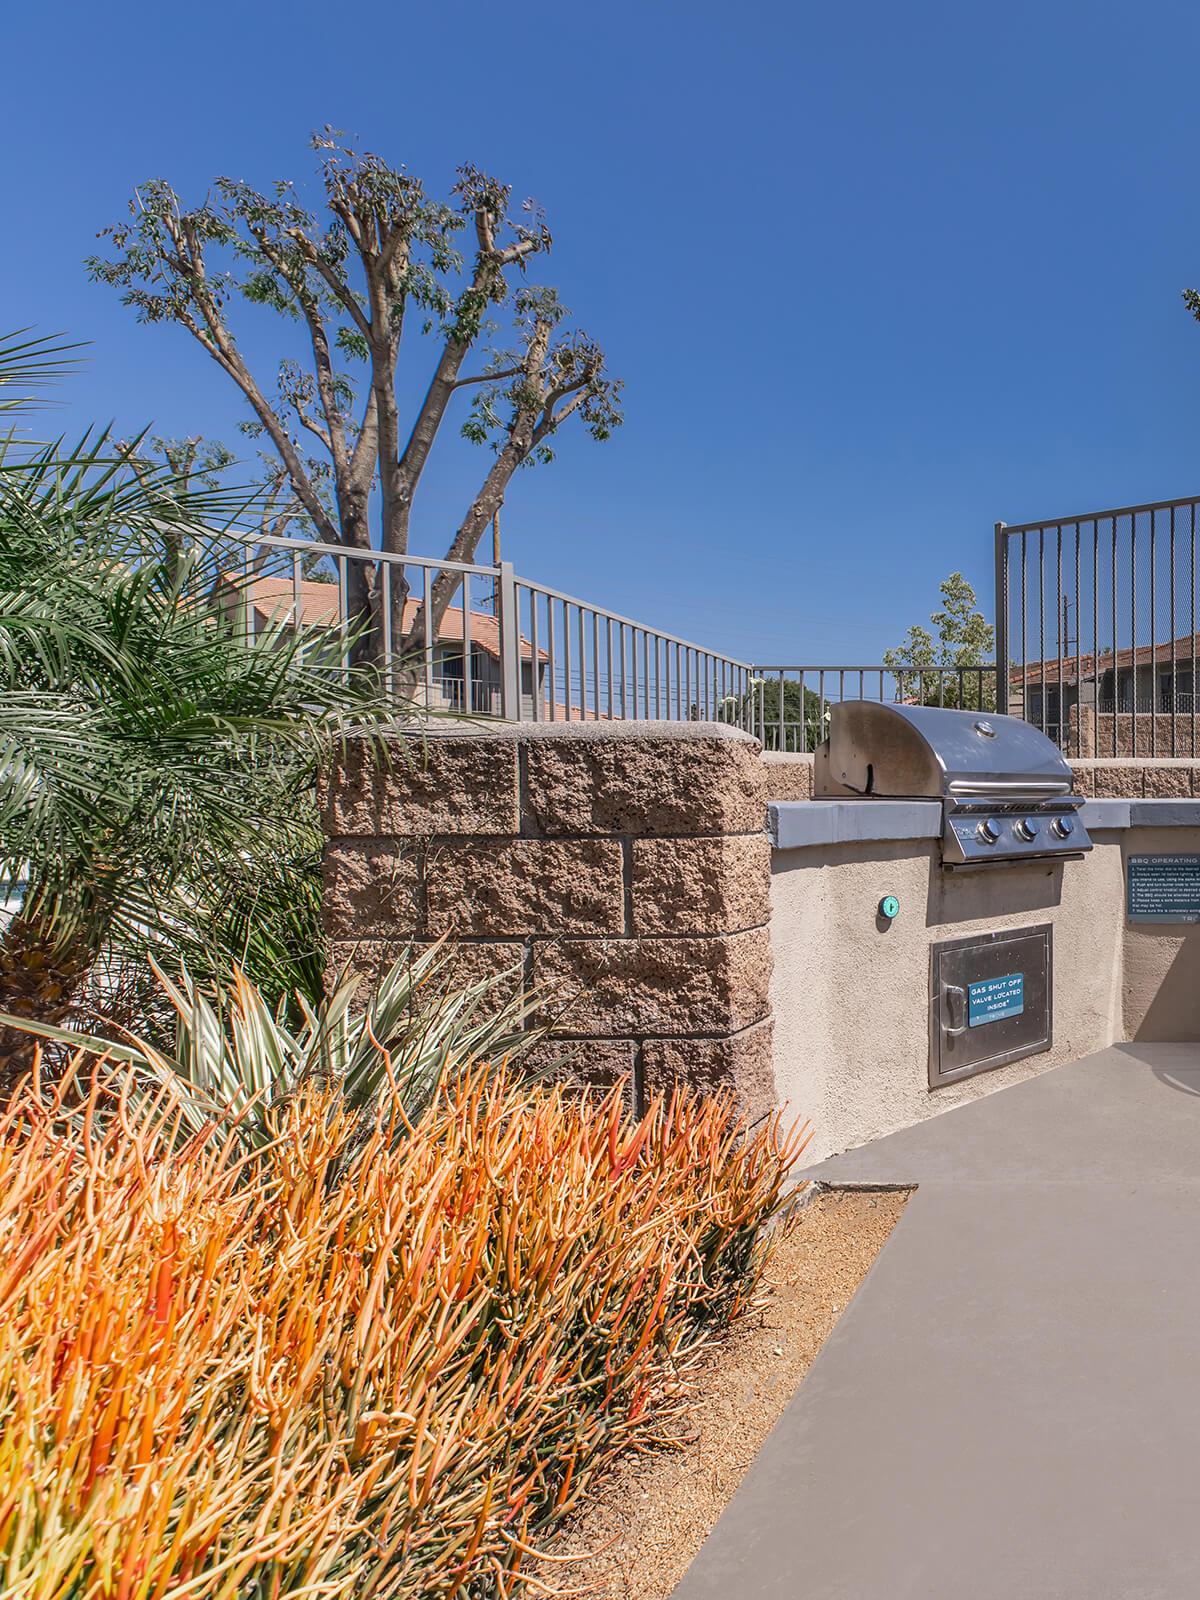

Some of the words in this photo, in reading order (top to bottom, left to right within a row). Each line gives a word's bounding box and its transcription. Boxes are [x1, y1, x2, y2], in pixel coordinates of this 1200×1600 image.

[970, 986, 986, 996] GAS
[988, 982, 1007, 992] SHUT
[1008, 978, 1022, 987] OFF
[972, 995, 992, 1005] VALVE
[993, 988, 1022, 1000] LOCATED
[986, 1001, 1007, 1011] INSIDE
